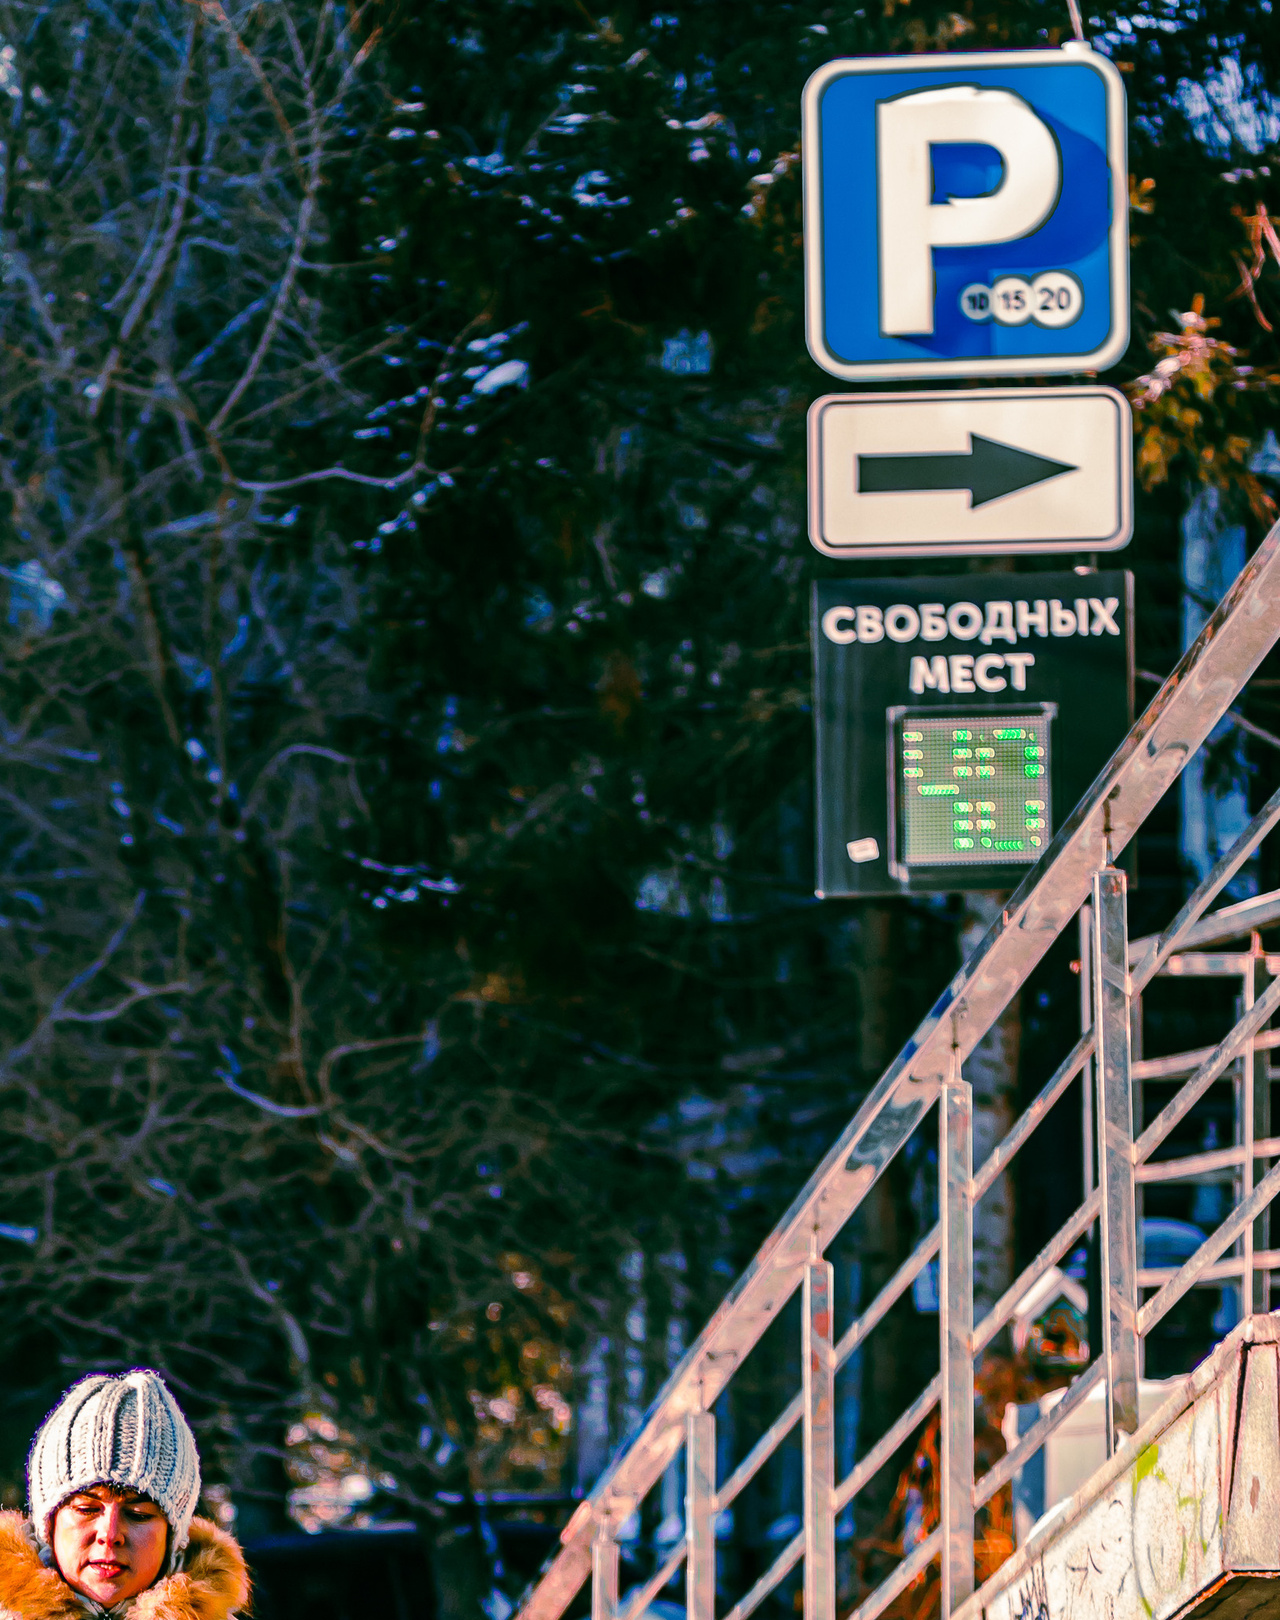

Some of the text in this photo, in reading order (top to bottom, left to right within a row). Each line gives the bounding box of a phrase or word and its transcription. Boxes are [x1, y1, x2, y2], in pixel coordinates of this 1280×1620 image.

[877, 85, 1060, 336] P
[1000, 288, 1026, 311] 15
[1039, 286, 1071, 311] 20
[822, 597, 1120, 644] СВОБОДНЫХ
[908, 653, 1035, 694] МЕСТ
